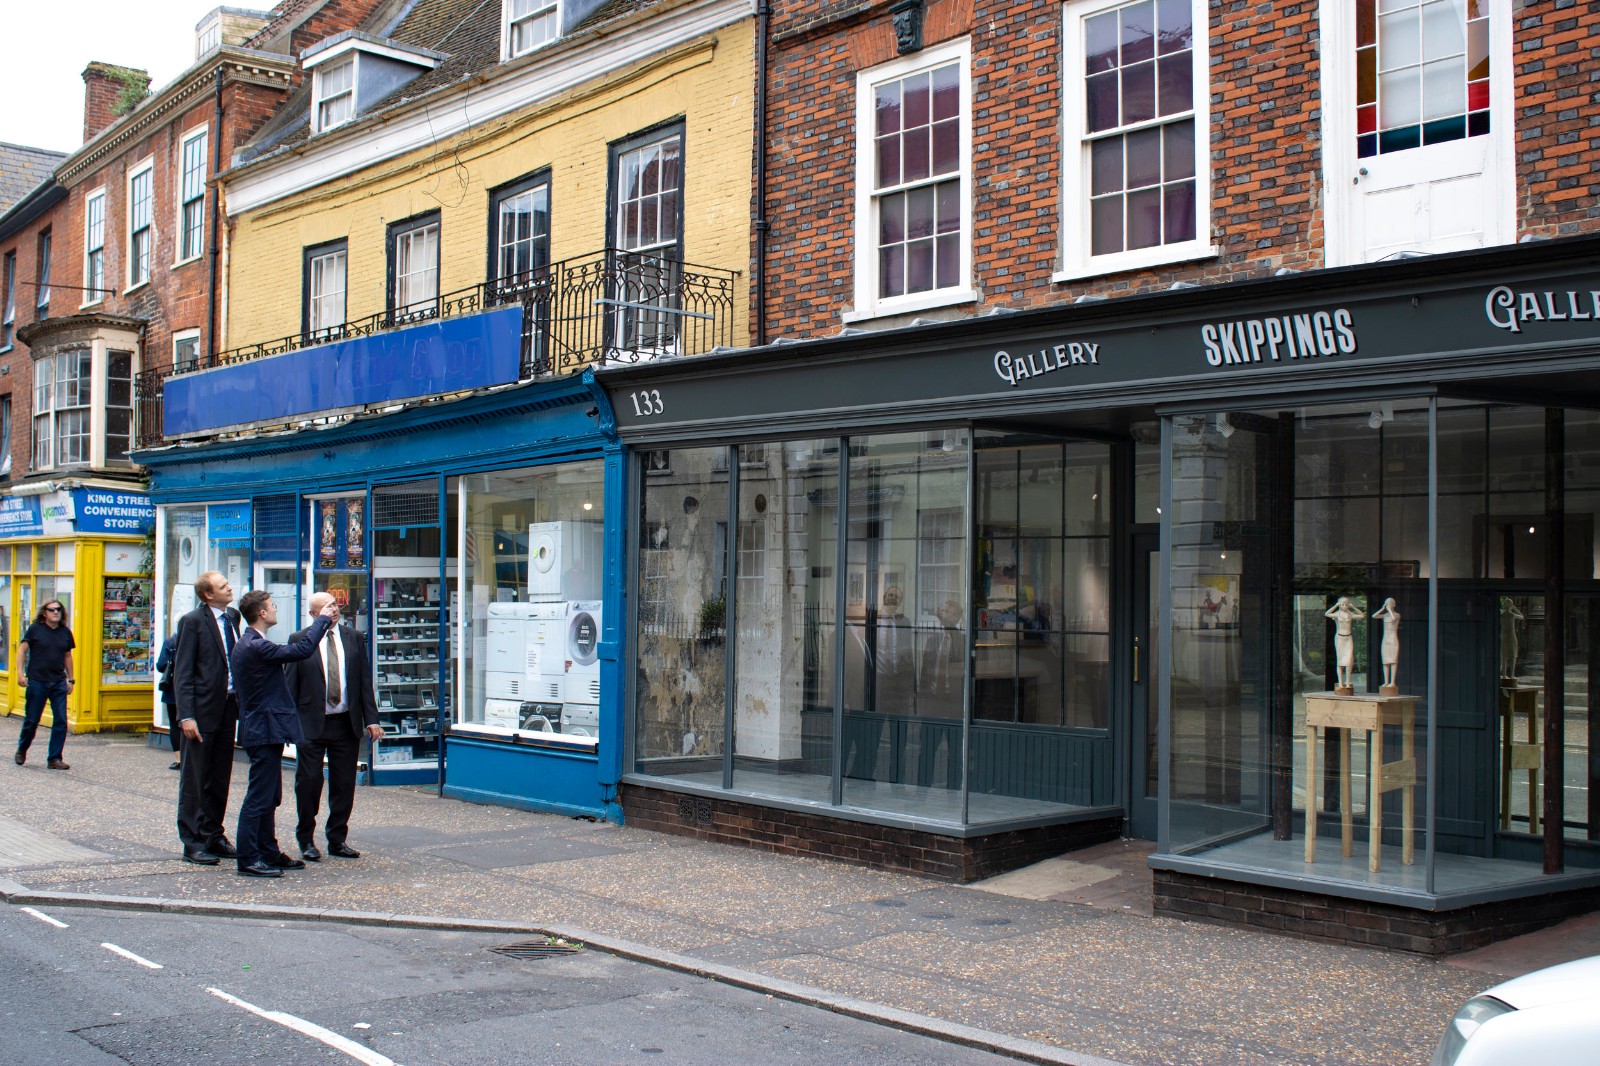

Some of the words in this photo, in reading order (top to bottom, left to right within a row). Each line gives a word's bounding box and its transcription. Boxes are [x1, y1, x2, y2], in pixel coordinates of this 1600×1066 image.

[1201, 308, 1357, 367] SKIPPINGS
[994, 342, 1099, 386] GALLERY
[630, 389, 664, 416] 133
[87, 494, 114, 504] KING
[116, 495, 155, 506] STREE
[104, 518, 140, 529] STORE
[326, 588, 349, 606] PEN
